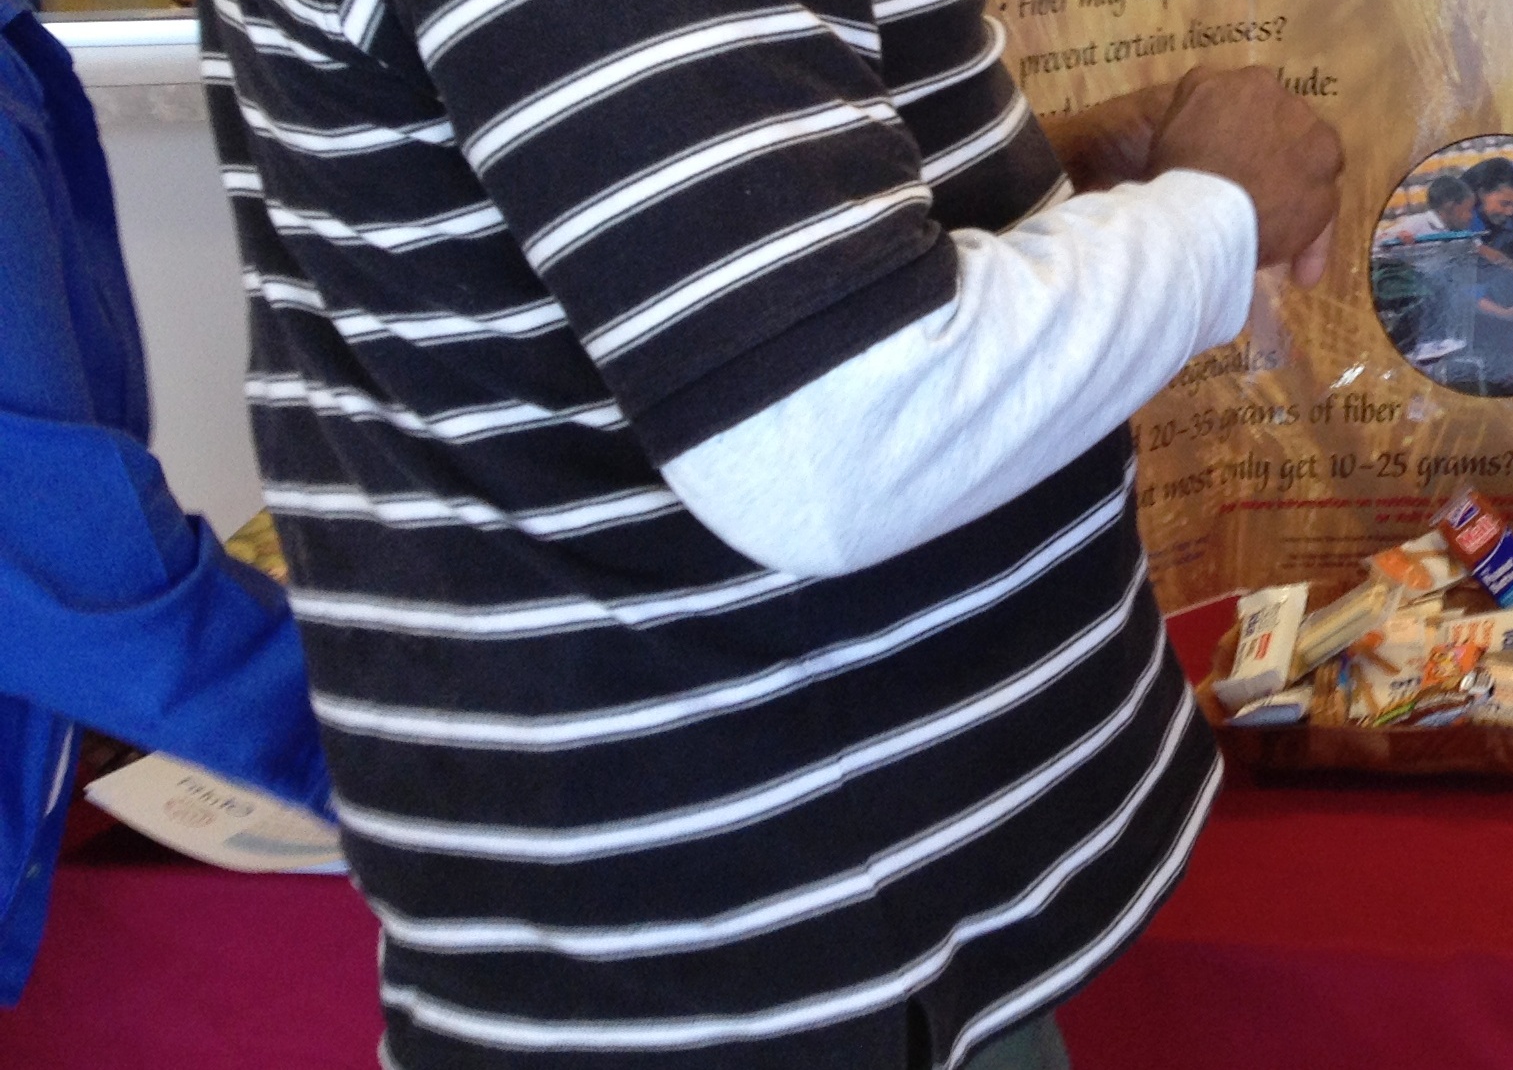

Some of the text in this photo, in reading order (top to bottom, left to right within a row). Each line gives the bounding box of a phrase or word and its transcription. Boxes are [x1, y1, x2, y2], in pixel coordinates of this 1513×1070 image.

[1018, 16, 1288, 88] prevent certain diseases?
[1308, 393, 1337, 425] of
[1340, 391, 1402, 424] fiber
[1278, 454, 1319, 493] get
